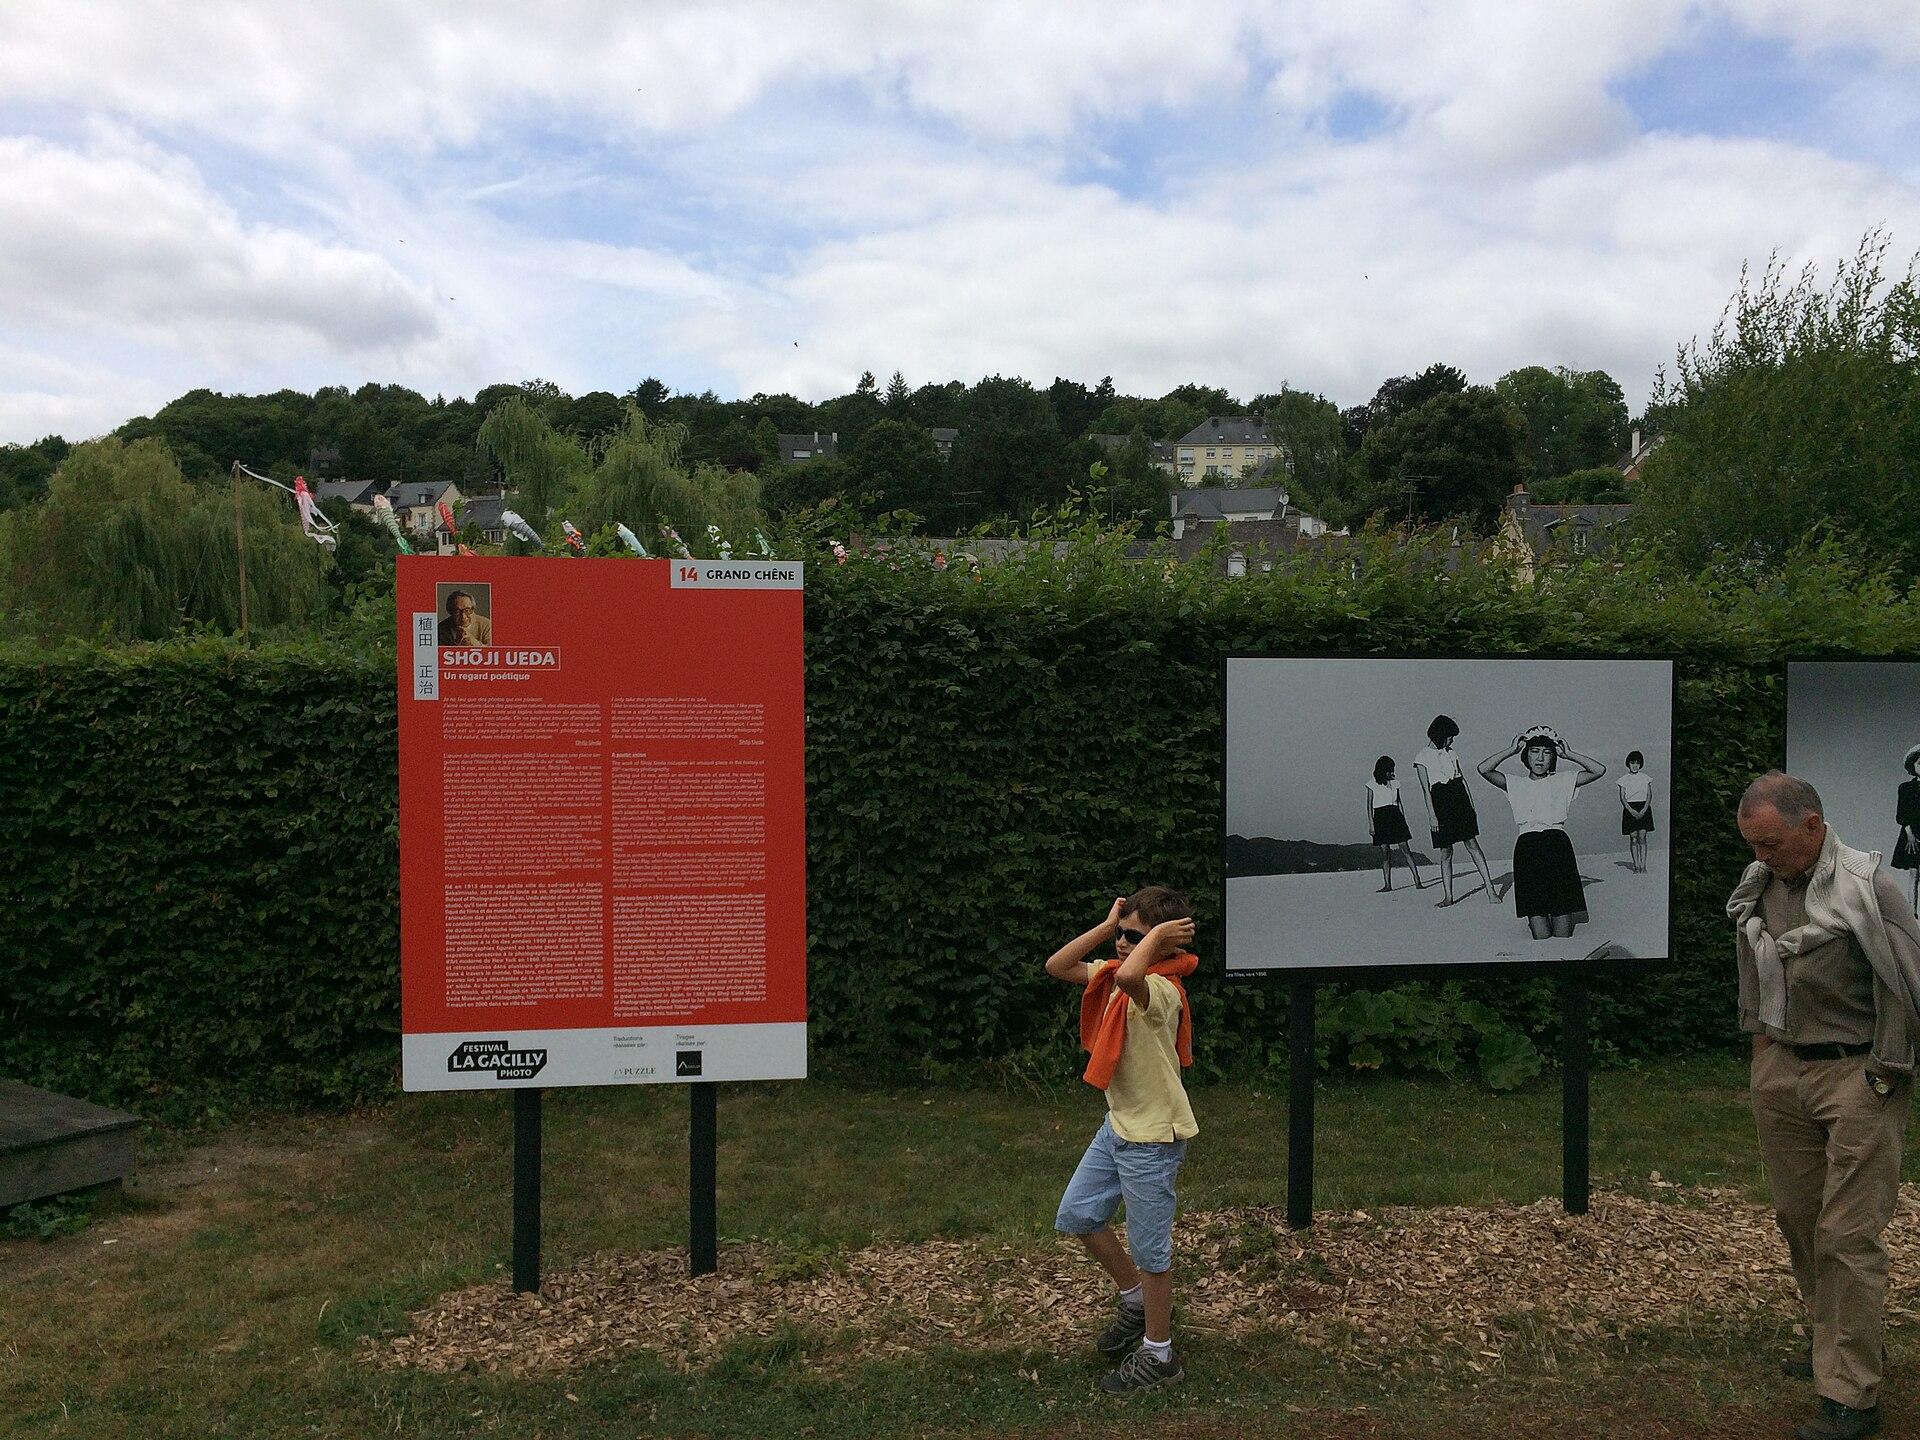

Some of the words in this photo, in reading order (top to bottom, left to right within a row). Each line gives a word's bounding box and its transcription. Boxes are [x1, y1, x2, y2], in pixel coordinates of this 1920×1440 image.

[679, 567, 698, 581] 14
[706, 569, 751, 580] GRAND
[754, 568, 795, 581] CHÊNE
[418, 617, 433, 647] 植田
[443, 649, 500, 666] SHŌJI
[505, 652, 556, 666] UEDA
[419, 665, 434, 695] 正治
[444, 672, 457, 680] Un
[458, 672, 488, 682] regard
[490, 672, 530, 682] poétique
[463, 1044, 505, 1052] FESTIVAL
[453, 1055, 475, 1068] LA
[477, 1053, 544, 1068] GACILLY
[500, 1069, 532, 1077] PHOTO
